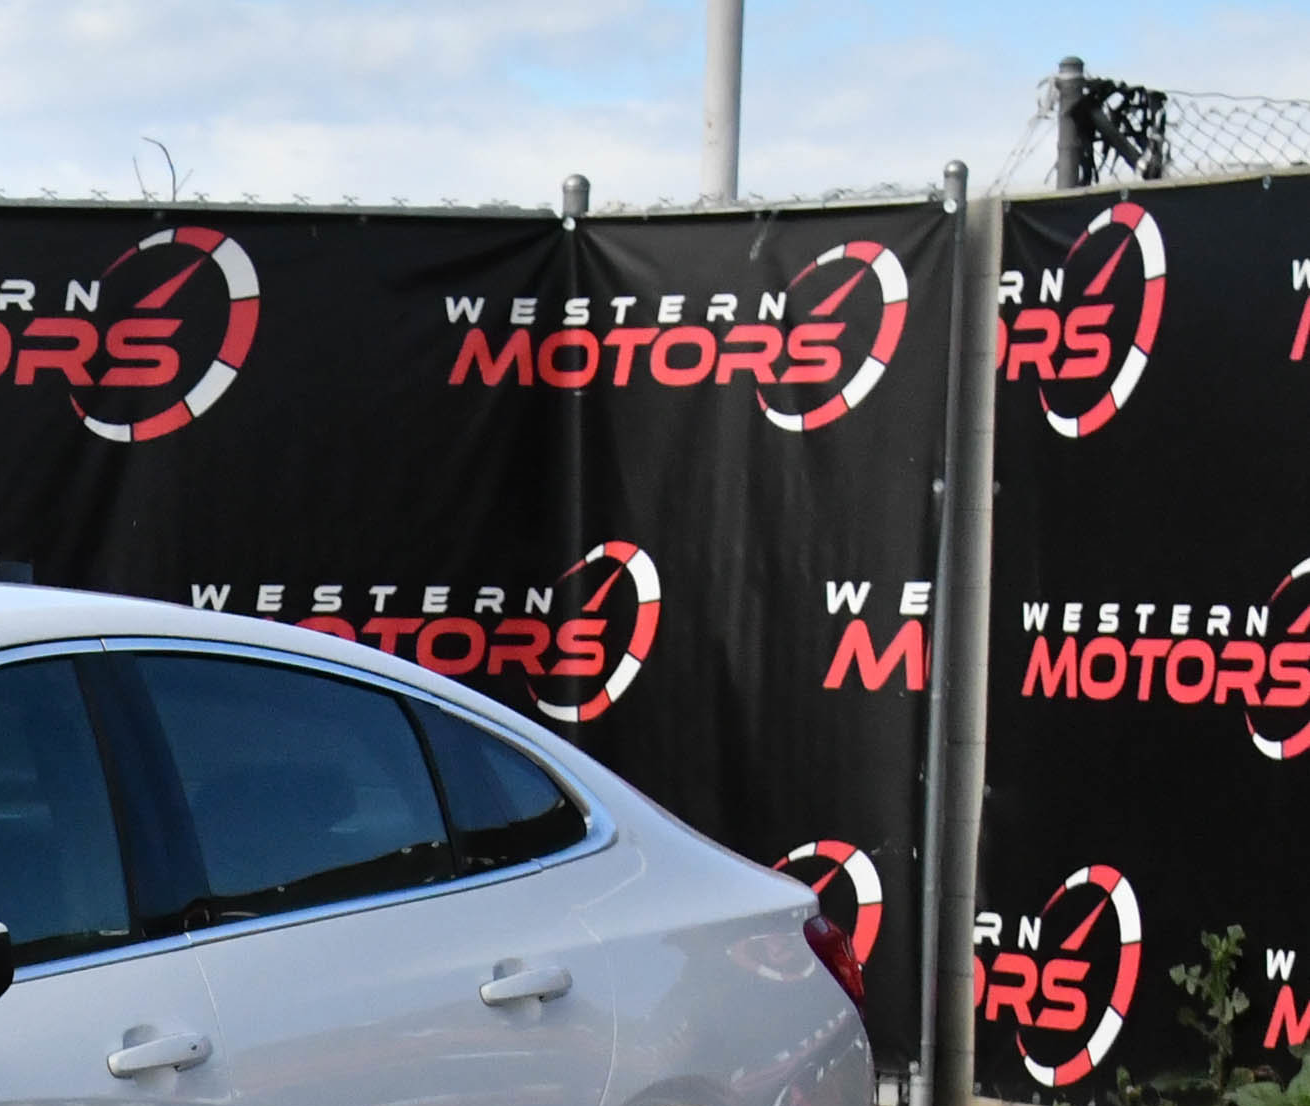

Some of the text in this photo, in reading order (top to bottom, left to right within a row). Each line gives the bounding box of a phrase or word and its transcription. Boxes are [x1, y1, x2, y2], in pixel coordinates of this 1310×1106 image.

[445, 291, 787, 326] WESTERN
[996, 303, 1116, 382] RS
[448, 321, 847, 389] MOTORS
[191, 583, 553, 614] WESTERN
[1022, 601, 1269, 637] WESTERN
[265, 615, 608, 677] TORS
[822, 618, 931, 691] M
[1021, 635, 1310, 708] MOTORS
[974, 952, 1091, 1032] RS
